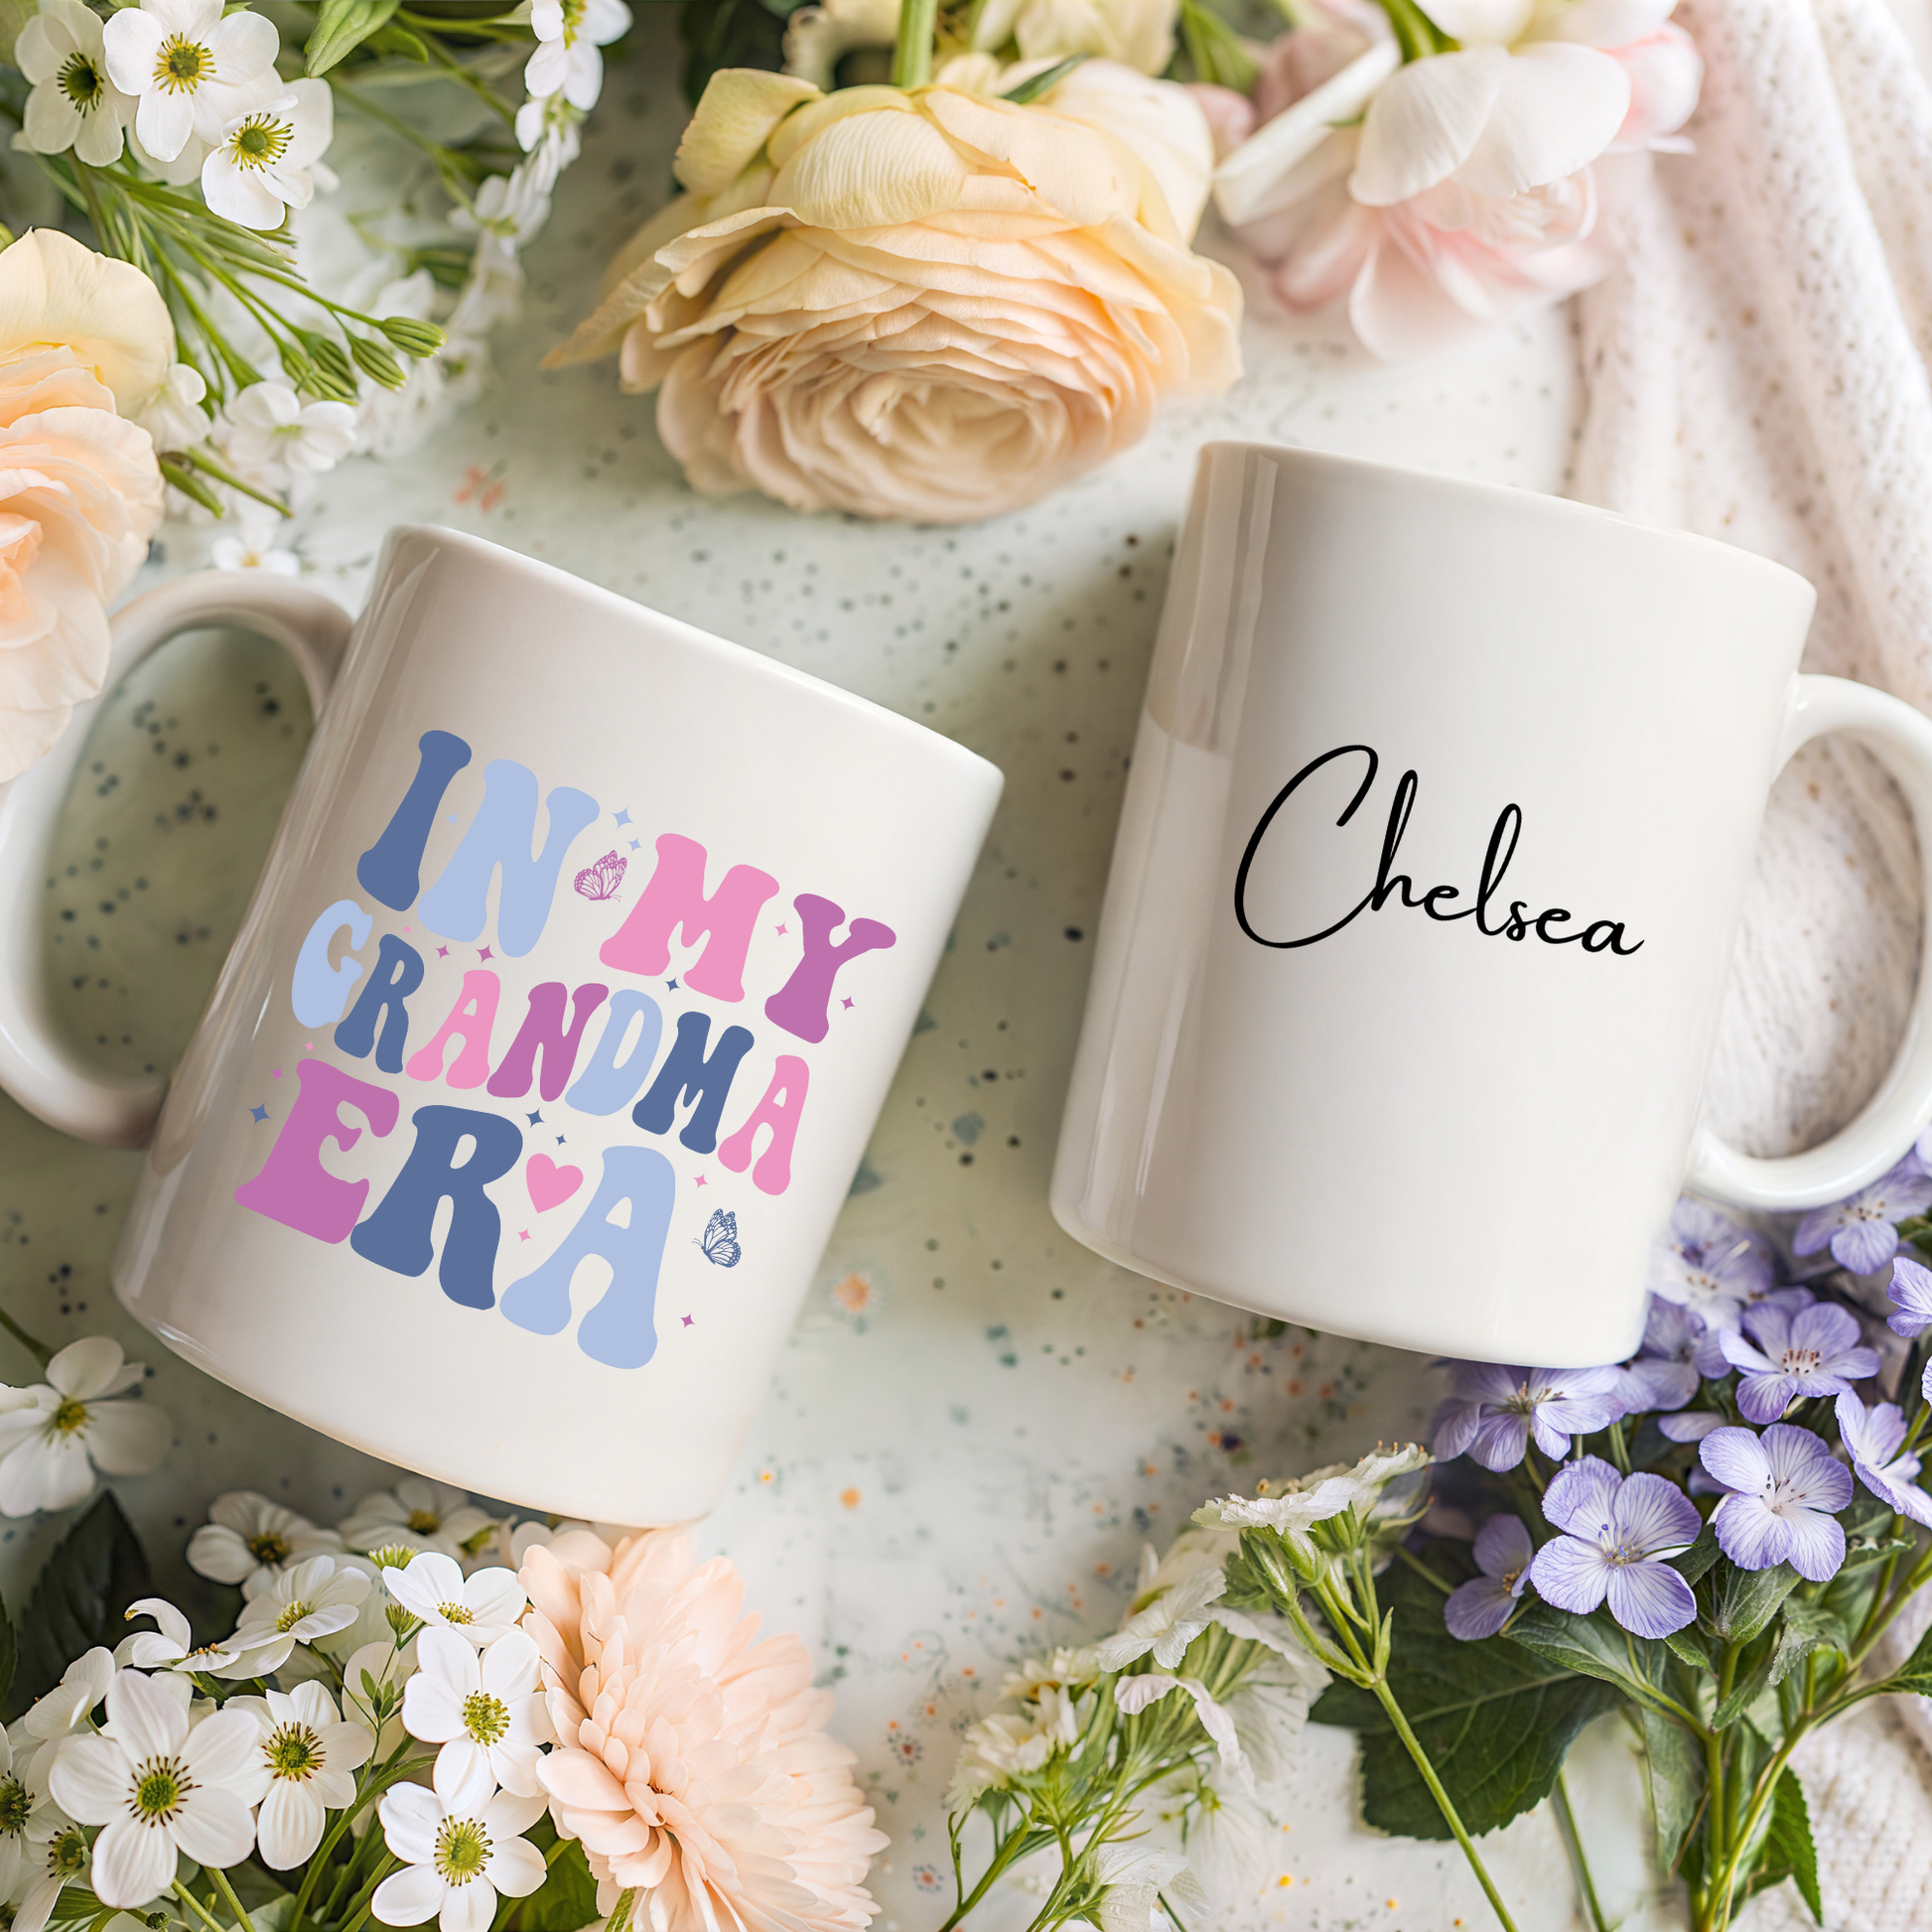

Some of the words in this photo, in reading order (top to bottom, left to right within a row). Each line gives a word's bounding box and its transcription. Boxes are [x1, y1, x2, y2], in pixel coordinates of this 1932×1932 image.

[356, 730, 601, 958] IN
[599, 832, 897, 1044] MY
[1234, 744, 1645, 955] Chelsea
[291, 898, 810, 1196] GRANDMA
[233, 1058, 676, 1370] ERA
